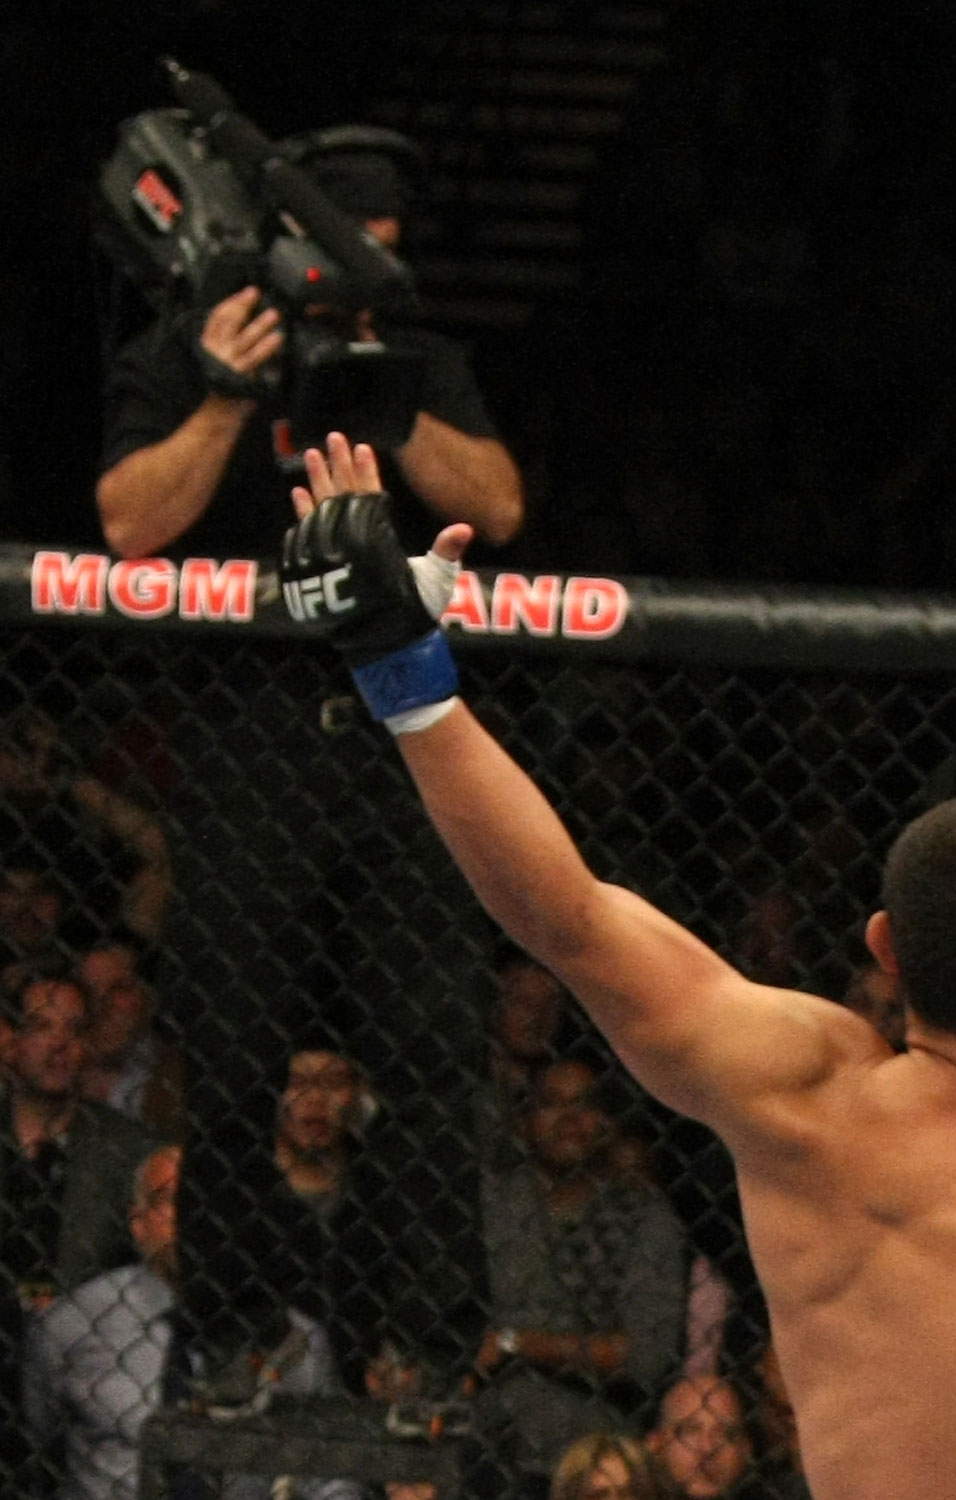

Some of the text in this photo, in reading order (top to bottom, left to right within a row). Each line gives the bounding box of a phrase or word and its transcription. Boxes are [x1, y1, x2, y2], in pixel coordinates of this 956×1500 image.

[31, 550, 628, 640] MGM AND
[283, 562, 357, 622] UFC
